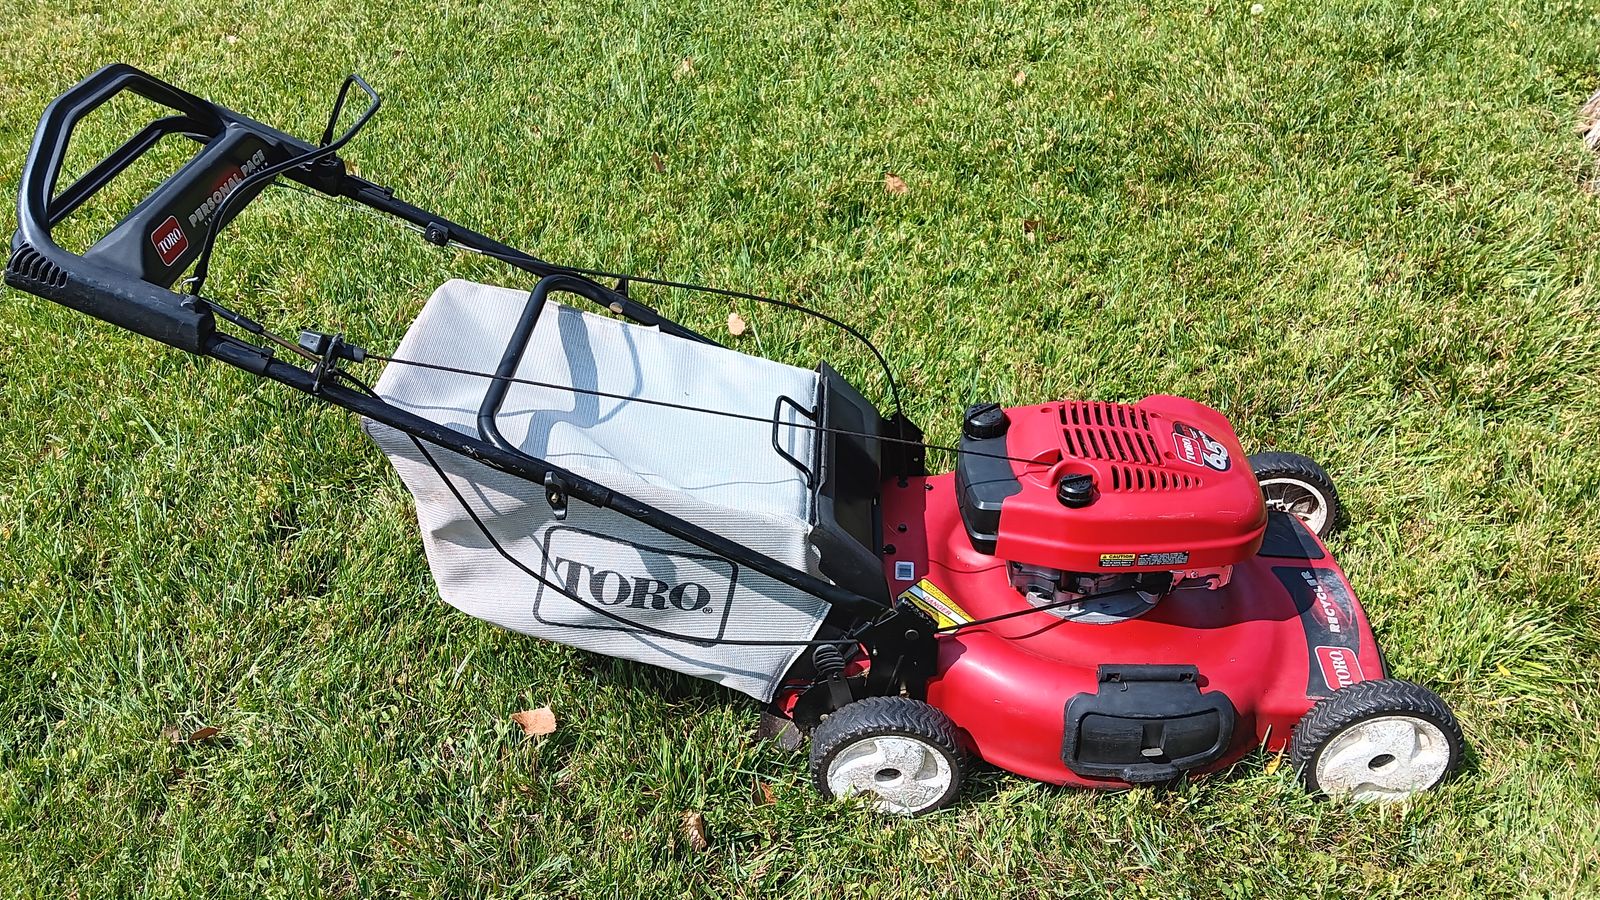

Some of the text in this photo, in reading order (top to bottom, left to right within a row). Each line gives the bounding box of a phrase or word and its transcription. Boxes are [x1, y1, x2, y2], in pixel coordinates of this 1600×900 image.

[188, 149, 266, 228] PERSONAL PACE
[157, 227, 182, 255] TORO
[1181, 437, 1196, 461] TORO
[555, 556, 711, 611] TORO
[1300, 570, 1341, 633] RECYCLER
[923, 595, 952, 616] DANGER
[1329, 650, 1353, 688] TORO
